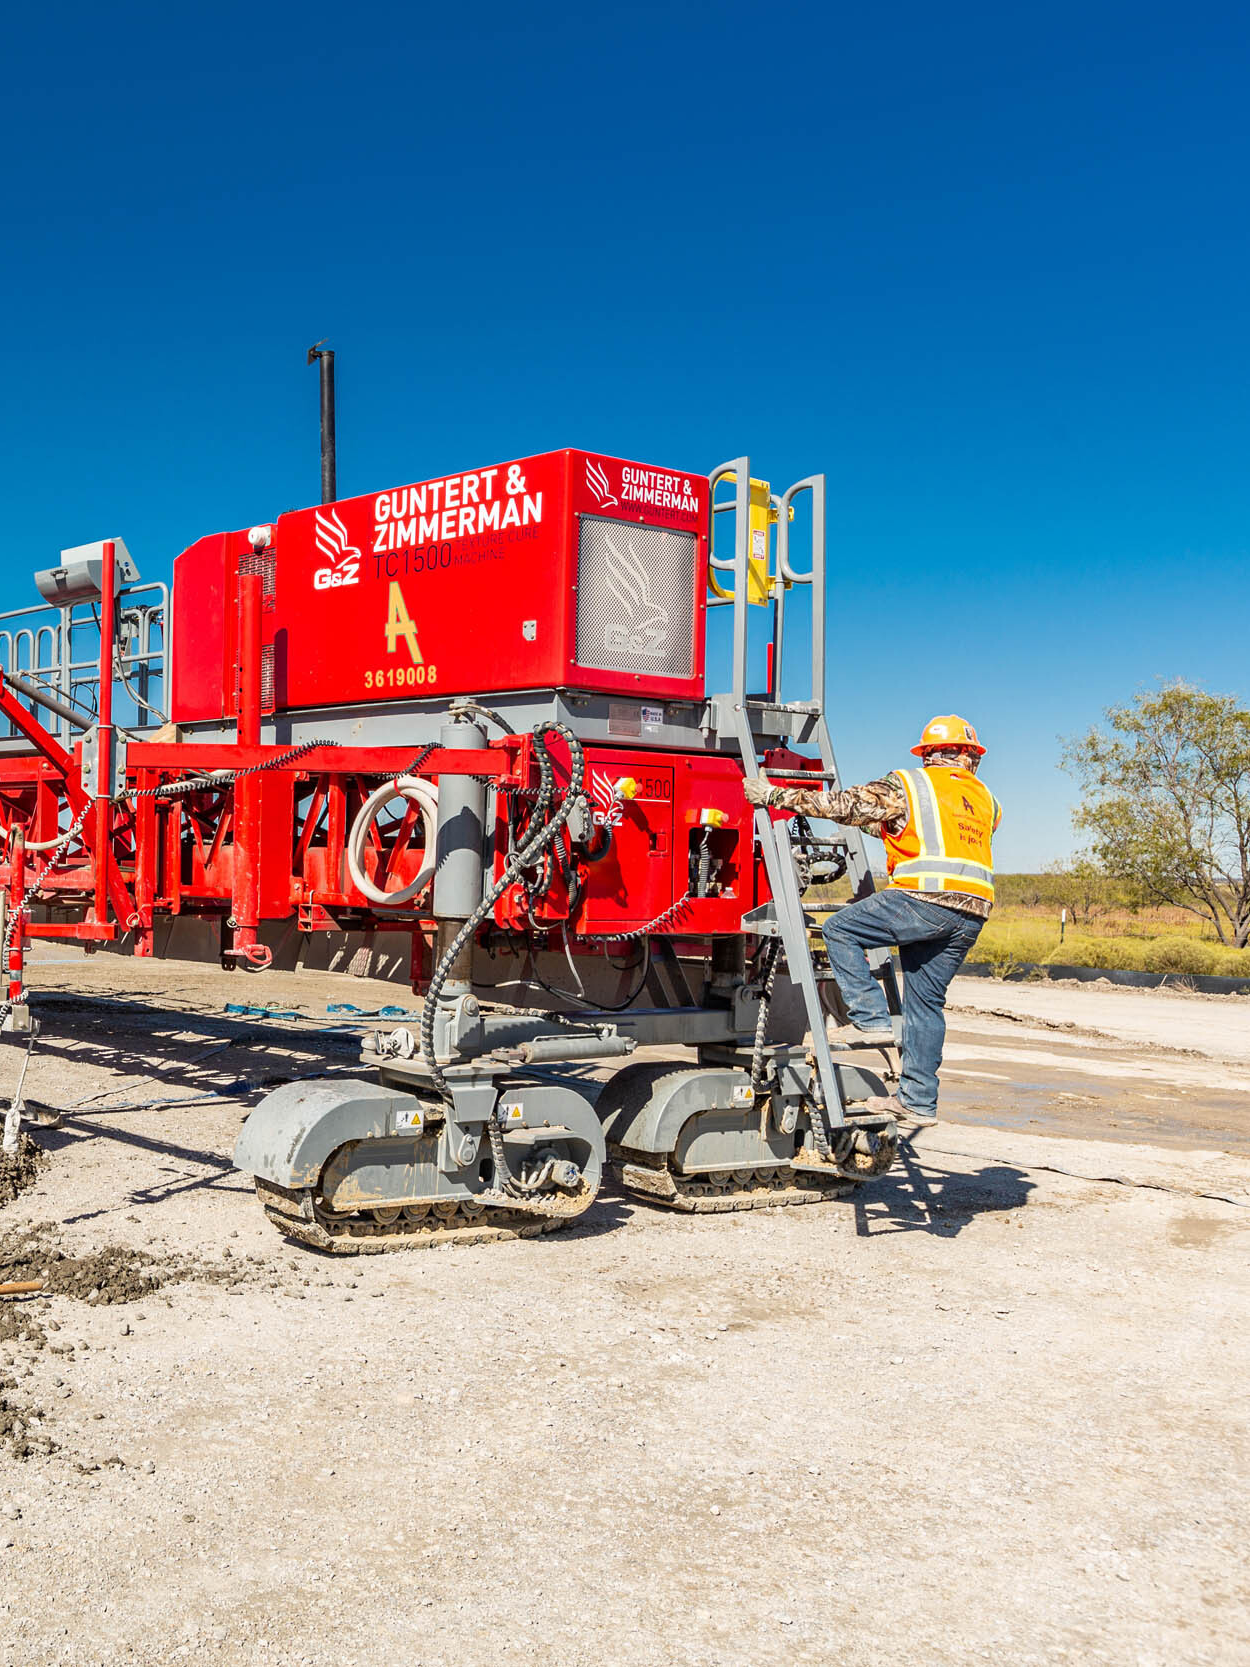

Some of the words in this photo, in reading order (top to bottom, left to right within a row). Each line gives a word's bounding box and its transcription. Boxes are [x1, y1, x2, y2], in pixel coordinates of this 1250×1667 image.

[374, 469, 498, 522] GUNTERT
[505, 464, 527, 495] &
[621, 466, 681, 493] GUNTERT
[683, 479, 692, 496] &
[621, 483, 699, 513] ZIMMERMAN
[373, 492, 543, 553] ZIMMERMAN
[456, 532, 504, 551] TEXTURE
[507, 526, 540, 544] CURE
[373, 542, 452, 579] TC1500
[454, 548, 505, 567] MACHINE
[313, 563, 360, 590] G&Z
[384, 581, 424, 664] A
[364, 665, 437, 688] 3619008
[958, 822, 984, 838] Safety
